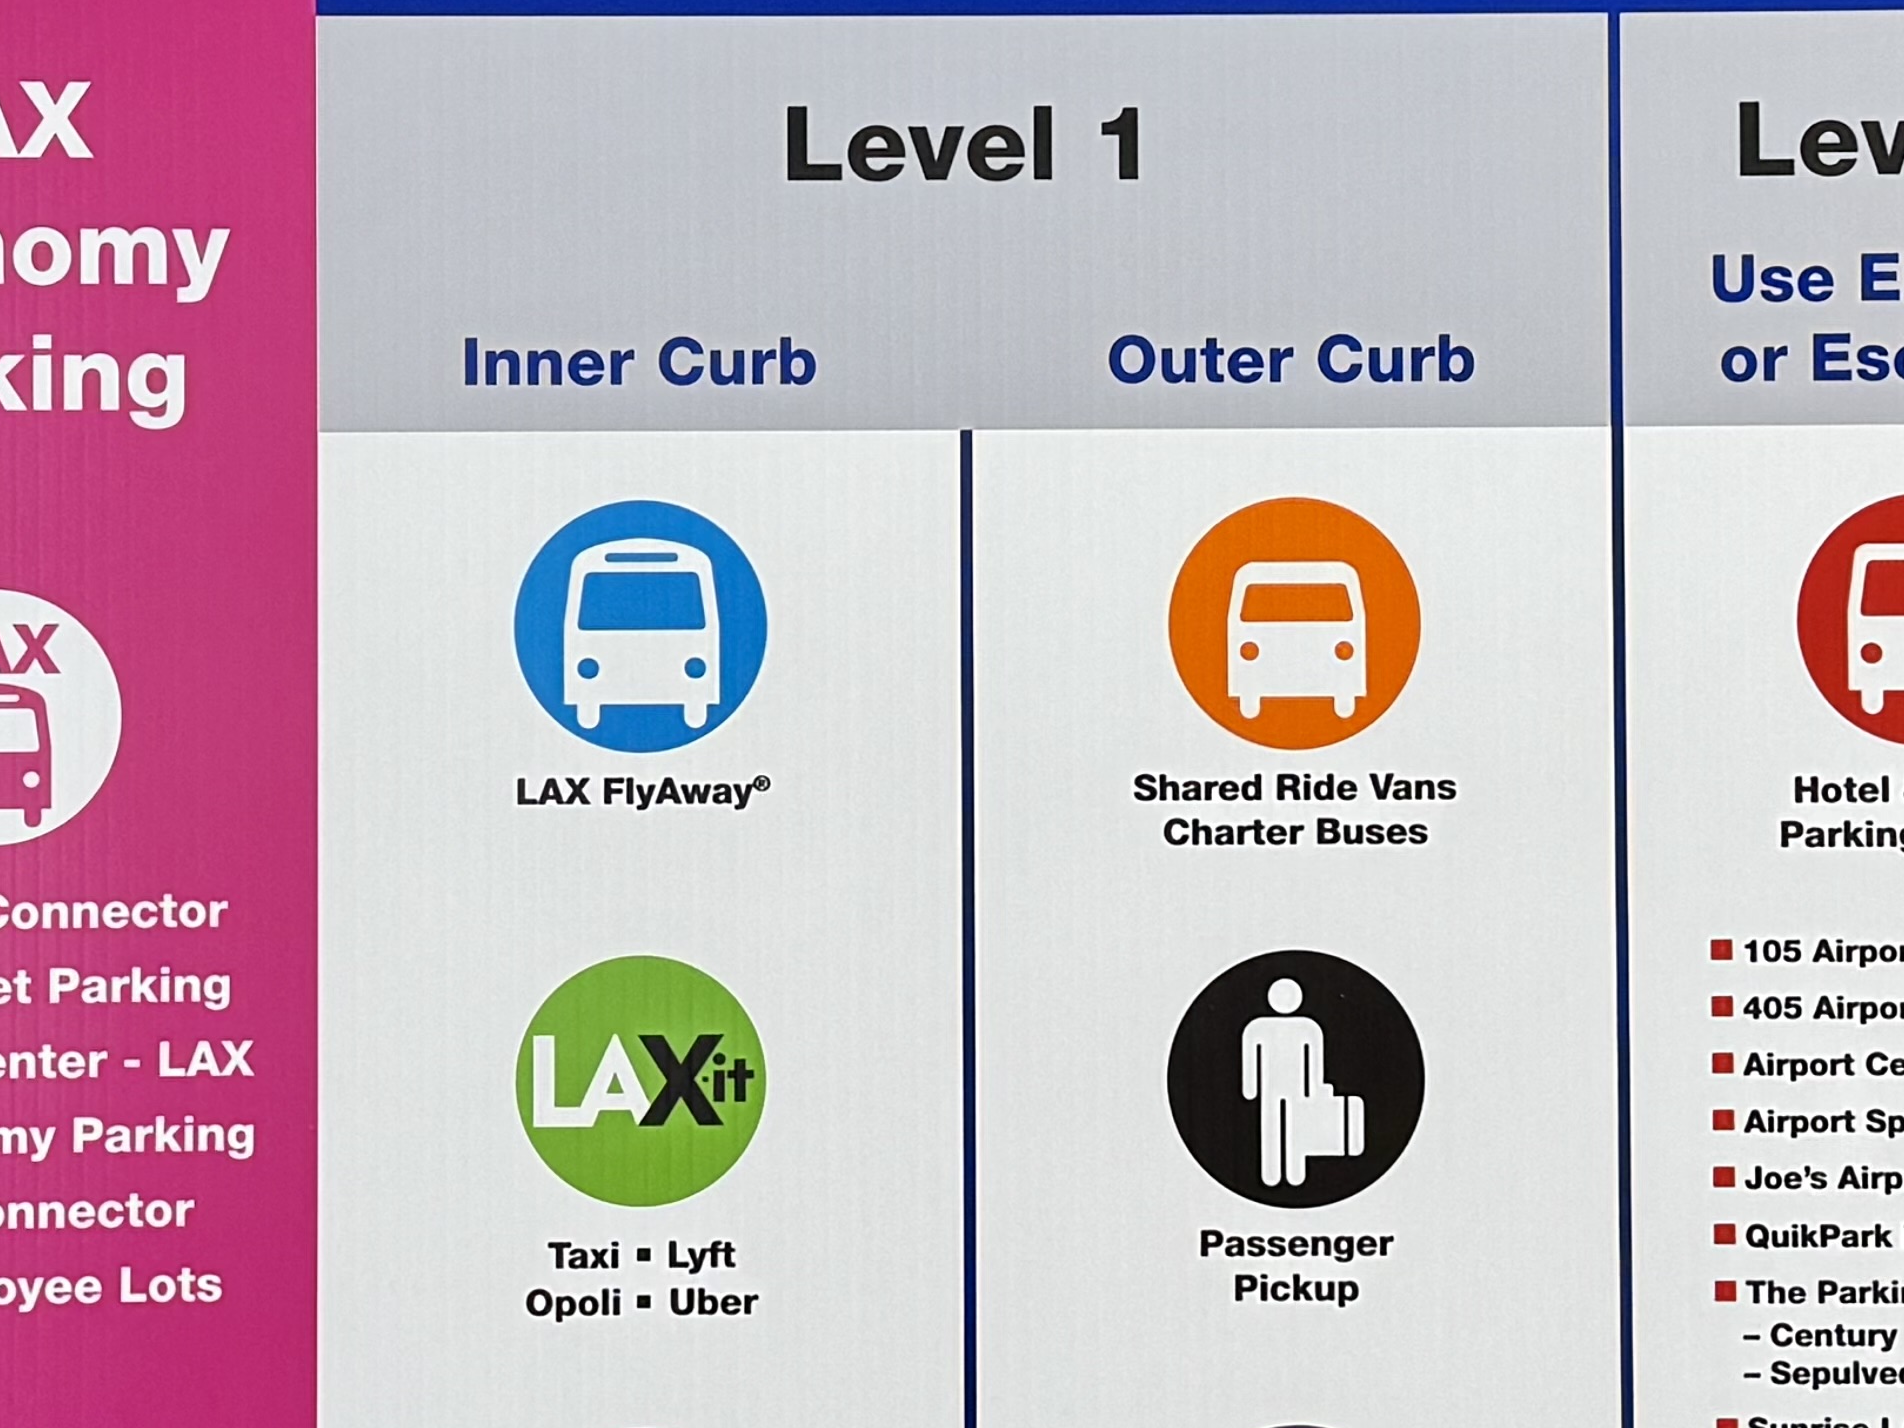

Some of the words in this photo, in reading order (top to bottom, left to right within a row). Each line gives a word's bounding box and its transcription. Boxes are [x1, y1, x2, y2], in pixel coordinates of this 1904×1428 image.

[787, 106, 1054, 183] Level
[1102, 107, 1140, 181] 1
[1713, 254, 1835, 304] Use
[465, 338, 636, 388] Inner
[659, 337, 818, 388] Curb
[1109, 335, 1295, 386] Outer
[1318, 334, 1476, 385] Curb
[1721, 346, 1790, 384] or
[518, 778, 592, 807] LAX
[1134, 774, 1263, 803] Shared
[1277, 774, 1359, 802] Ride
[1370, 773, 1458, 802] Vans
[1795, 776, 1891, 805] Hotel
[1164, 818, 1306, 847] Charter
[1317, 818, 1429, 846] Buses
[1745, 940, 1803, 964] 105
[50, 967, 232, 1012] Parking
[1744, 996, 1804, 1021] 405
[160, 1041, 256, 1078] LAX
[1744, 1053, 1856, 1084] Airport
[74, 1116, 256, 1161] Parking
[1744, 1110, 1857, 1140] Airport
[1745, 1166, 1829, 1191] Joe's
[1201, 1230, 1396, 1264] Passenger
[1746, 1224, 1894, 1251] QuikPark
[548, 1242, 621, 1271] Taxi
[669, 1241, 738, 1276] Lyft
[121, 1267, 224, 1304] Lots
[1235, 1274, 1361, 1309] Pickup
[1746, 1280, 1808, 1306] The
[526, 1289, 622, 1324] Opoli
[671, 1288, 761, 1317] Uber
[1771, 1323, 1899, 1354] Century
